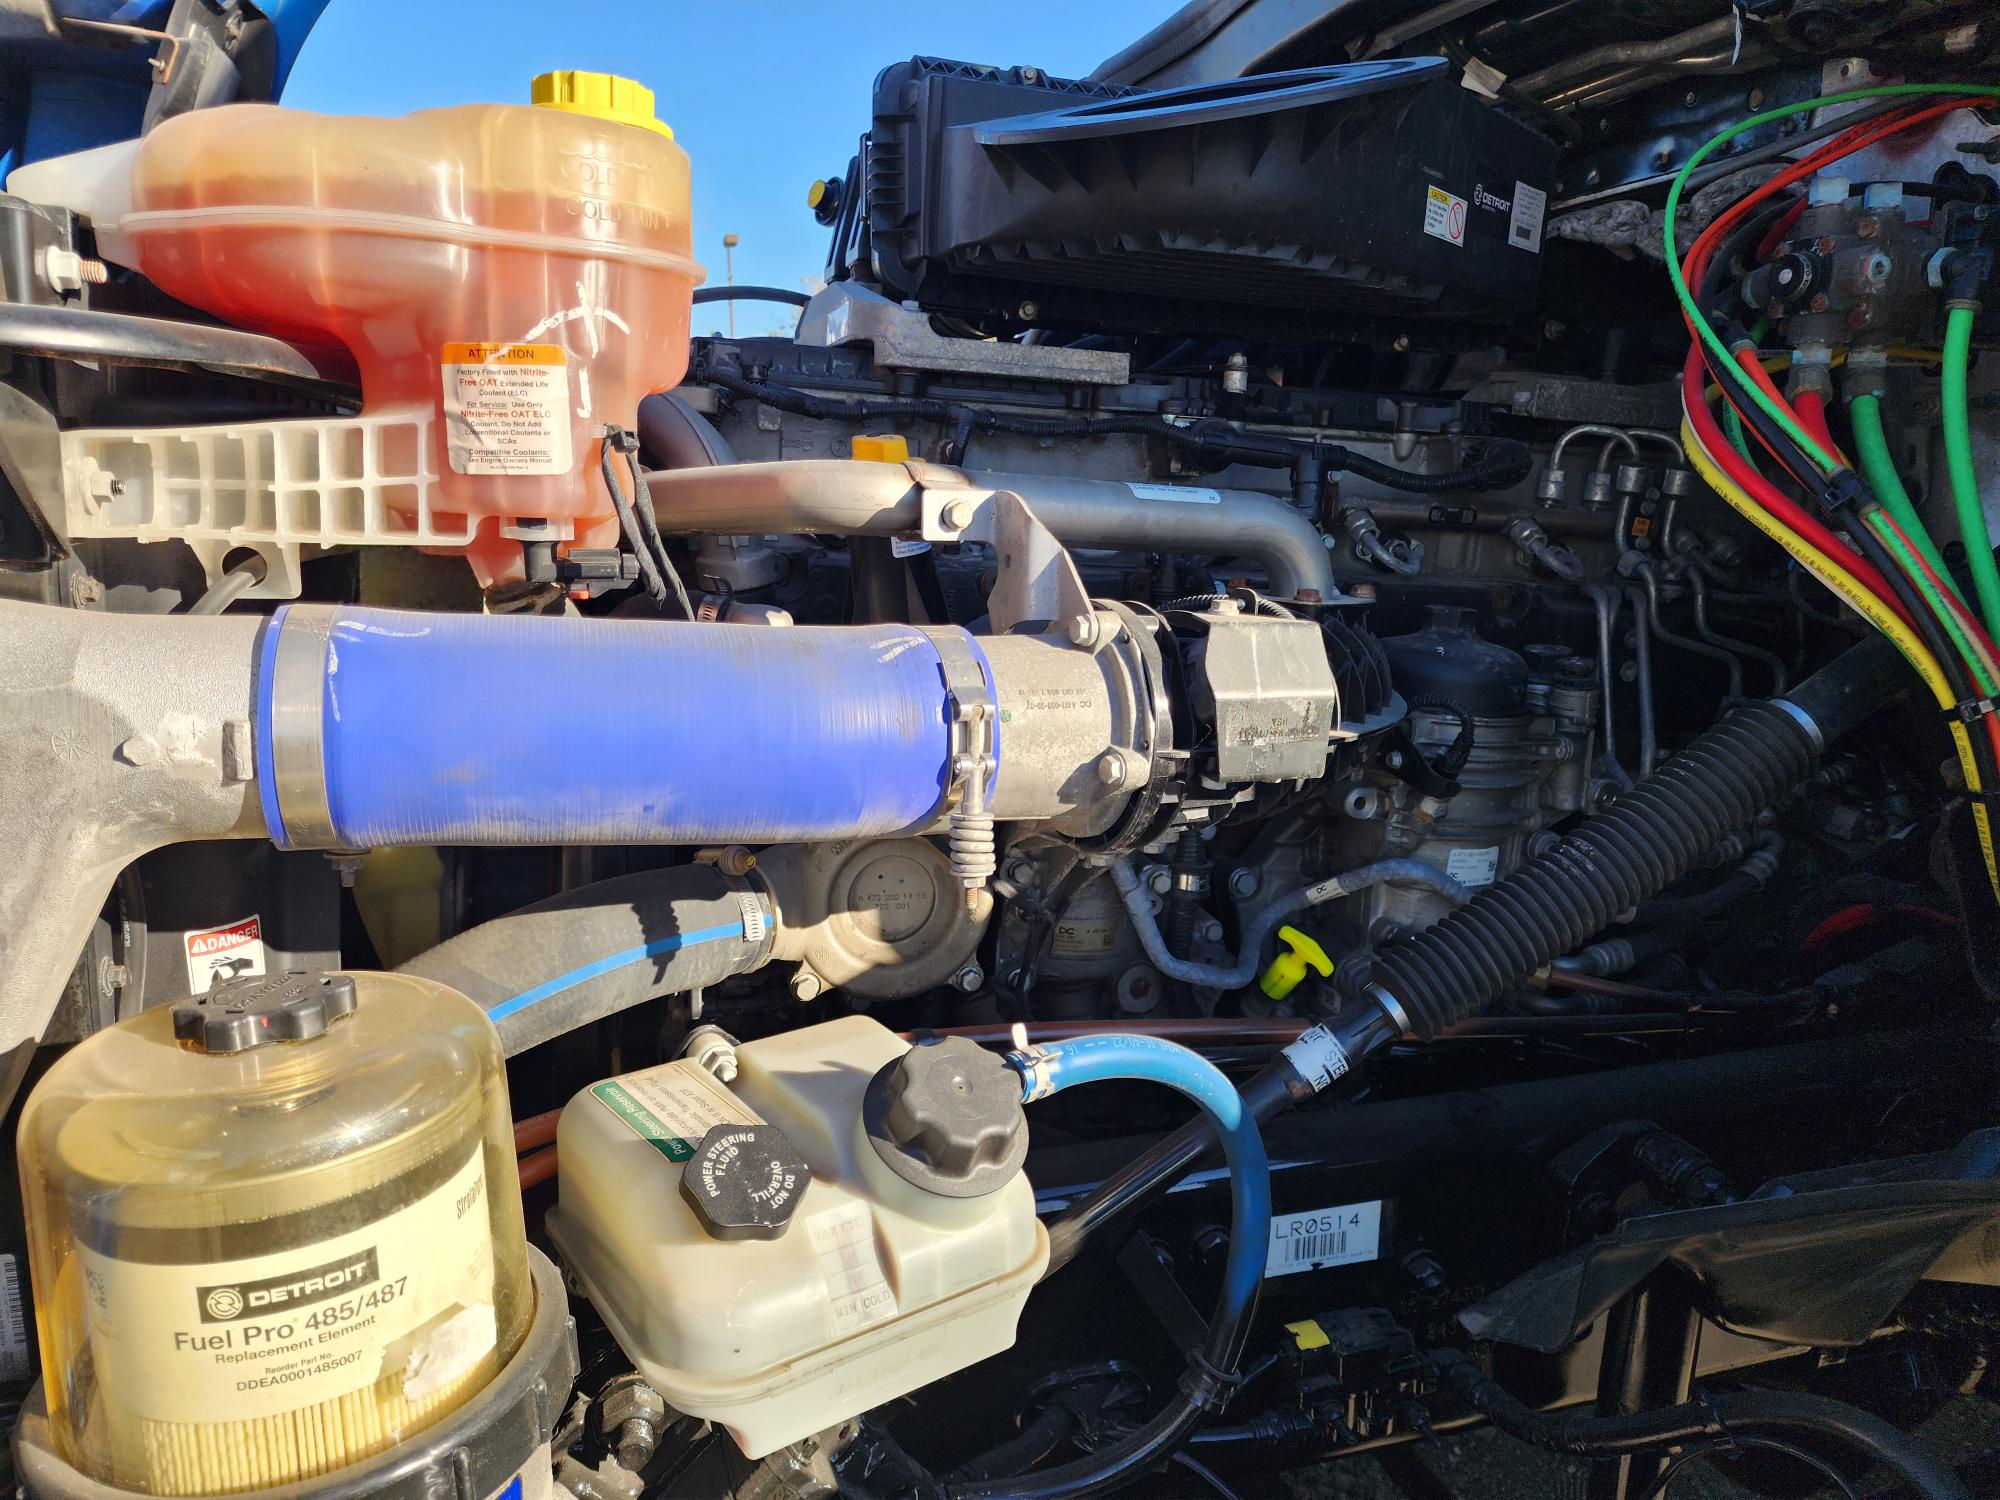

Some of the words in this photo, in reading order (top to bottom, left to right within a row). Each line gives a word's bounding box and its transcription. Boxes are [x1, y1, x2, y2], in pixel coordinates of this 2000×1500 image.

[566, 199, 622, 223] COLD
[631, 210, 659, 230] MIN
[1482, 192, 1511, 213] DETROIT
[456, 369, 480, 377] Factory
[482, 368, 501, 376] Filled
[520, 368, 550, 377] Nitrite-
[480, 378, 498, 386] OAT
[500, 380, 534, 388] Extended
[536, 380, 549, 388] Life
[508, 389, 528, 397] (ELC)
[461, 410, 508, 418] Nitrite-Free
[511, 410, 531, 418] OAT
[533, 410, 551, 418] ELC
[502, 420, 512, 428] Do
[513, 420, 526, 428] Not
[528, 420, 542, 428] Add
[468, 448, 511, 457] Compatible
[513, 448, 550, 457] Coolants:
[480, 457, 502, 465] Engine
[206, 924, 259, 952] DANGER
[605, 1086, 637, 1114] Reservoir
[634, 1110, 665, 1138] Steering
[707, 1132, 755, 1160] STEERING
[716, 1146, 739, 1176] FLUID
[702, 1162, 720, 1198] POWER
[752, 1161, 783, 1202] OVERFILL
[784, 1174, 796, 1189] DO
[770, 1190, 790, 1209] NOT
[1276, 1212, 1360, 1240] LR0514
[248, 1262, 368, 1308] DETROIT
[174, 1330, 232, 1352] Fuel
[244, 1324, 295, 1346] Pro
[304, 1276, 409, 1331] 485/487
[863, 1290, 891, 1310] COLD
[214, 1338, 314, 1365] Replacement
[318, 1314, 377, 1344] Element
[236, 1350, 363, 1392] DDEA0001485007
[264, 1362, 299, 1375] Reorder
[300, 1356, 319, 1367] Part
[320, 1352, 334, 1363] No.
